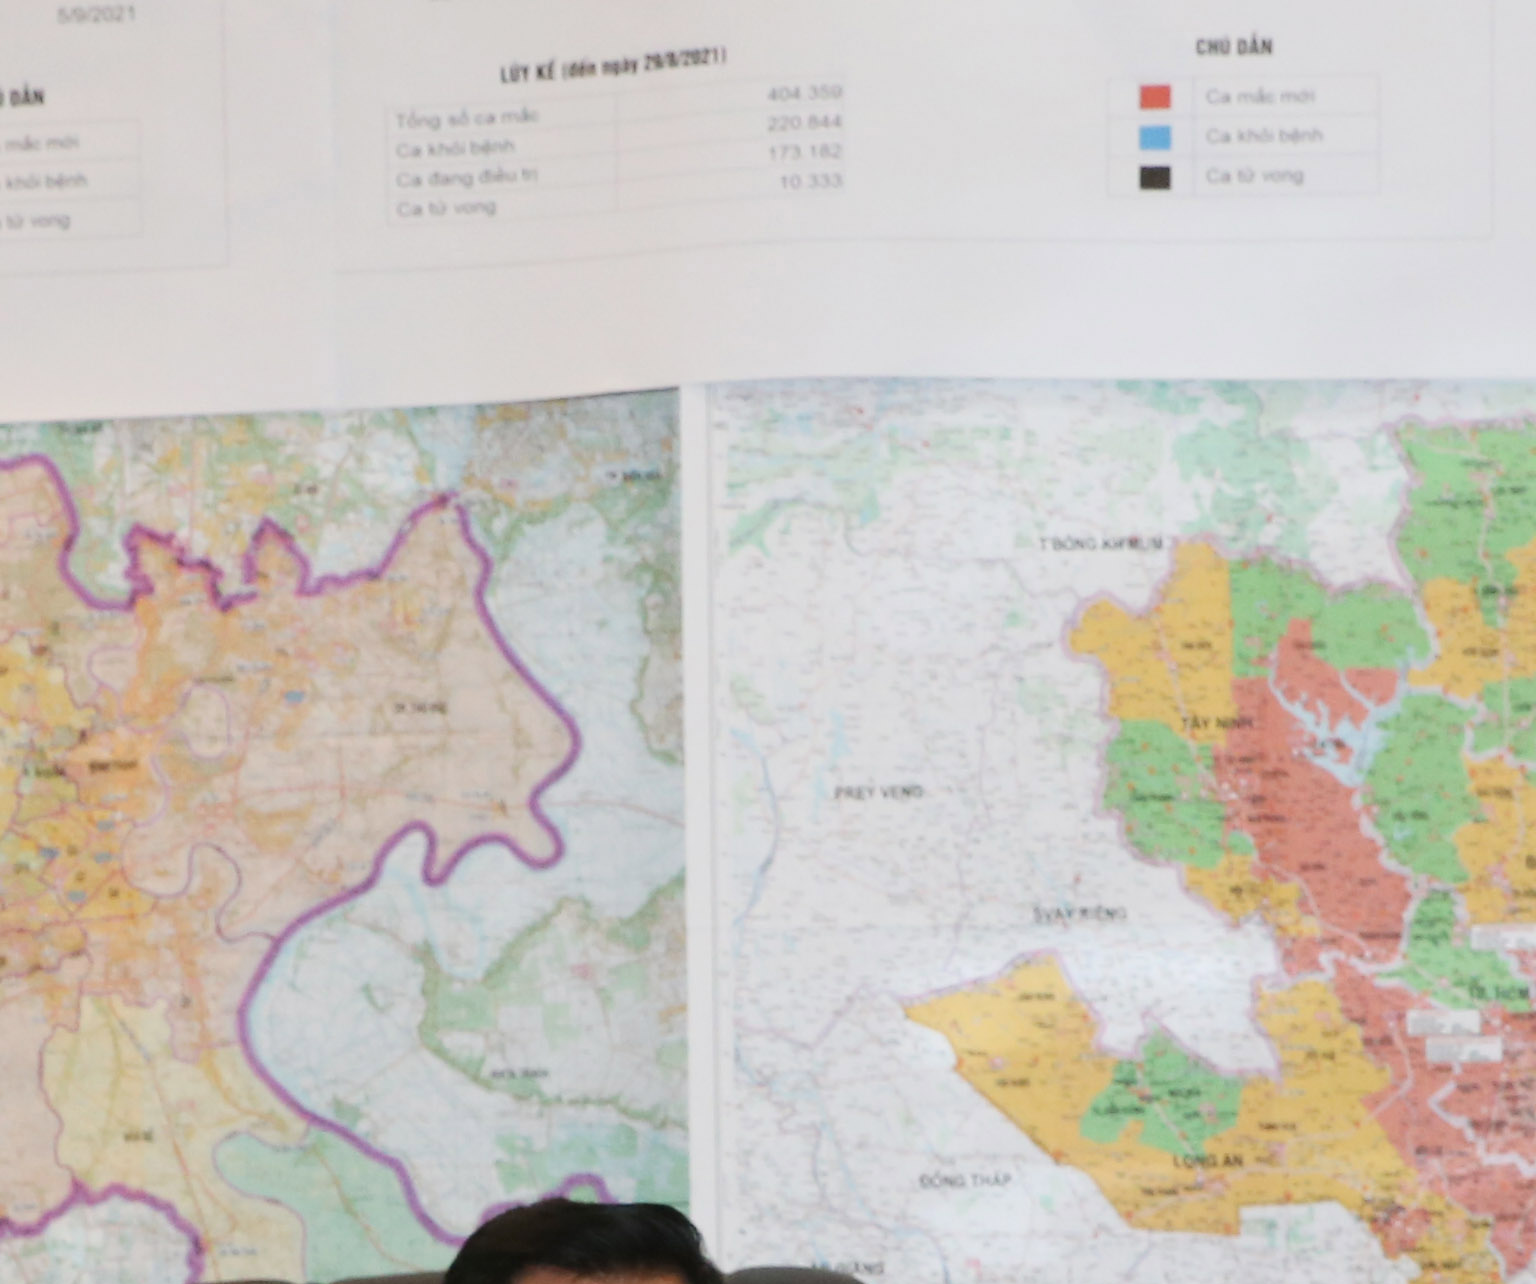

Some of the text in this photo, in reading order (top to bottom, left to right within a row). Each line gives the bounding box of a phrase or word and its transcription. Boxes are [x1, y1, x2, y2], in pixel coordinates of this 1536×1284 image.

[1195, 32, 1274, 56] CHÚ DẪN
[500, 63, 530, 85] LŨY
[536, 57, 556, 82] KẾ
[602, 56, 638, 77] ngày
[11, 82, 44, 107] DẪN
[1206, 88, 1232, 105] Ca
[474, 112, 496, 126] ca
[1206, 128, 1232, 145] Ca
[396, 141, 423, 160] Ca
[396, 172, 423, 190] Ca
[1206, 168, 1232, 185] Ca
[1262, 168, 1304, 187] vong
[396, 201, 423, 218] Ca
[453, 200, 497, 218] vong
[30, 213, 71, 232] vong
[1173, 1152, 1244, 1168] LONG AN
